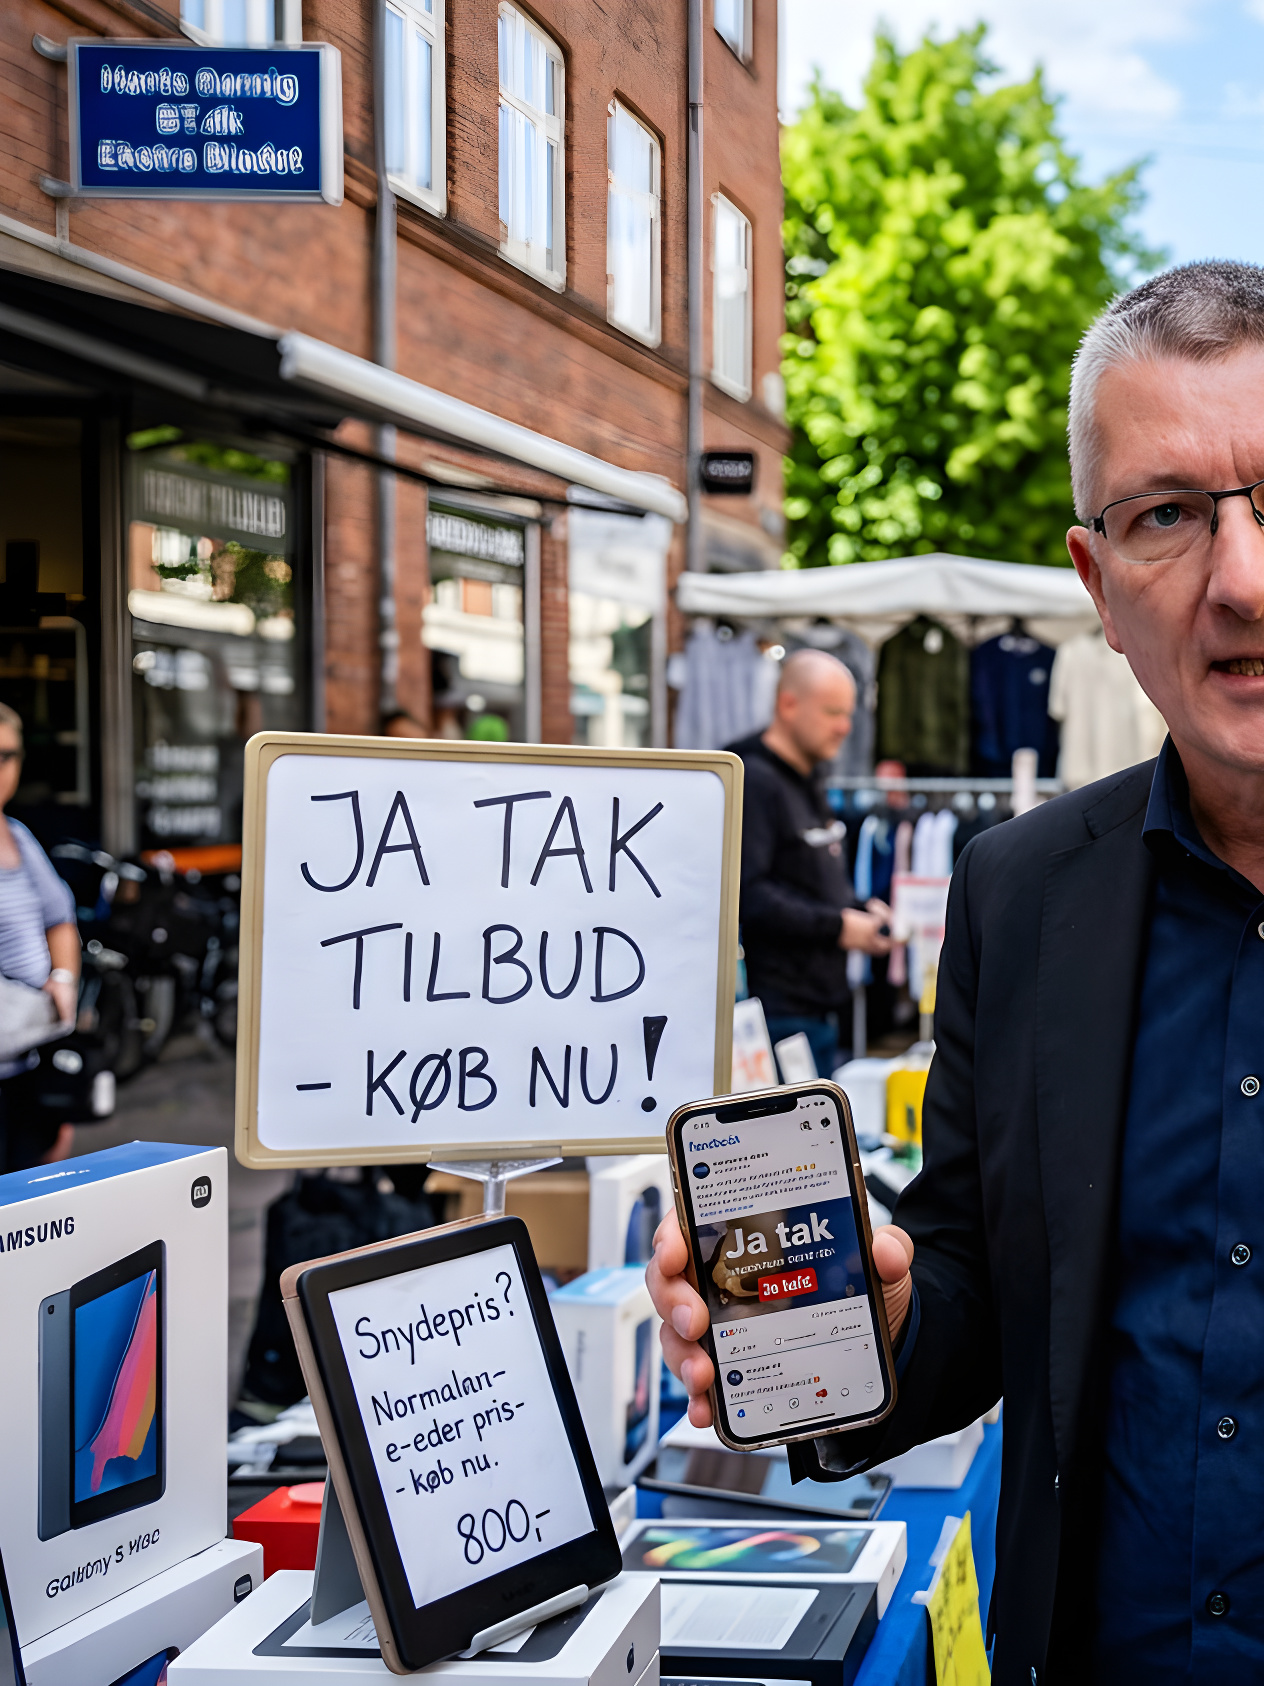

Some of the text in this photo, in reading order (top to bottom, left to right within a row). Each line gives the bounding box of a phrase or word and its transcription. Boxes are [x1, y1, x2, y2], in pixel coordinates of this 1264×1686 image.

[300, 790, 665, 898] JA TAK
[320, 922, 645, 1010] TILBUD
[366, 1046, 497, 1124] KØB
[0, 1216, 75, 1253] MSUNG
[726, 1212, 835, 1259] Ja tak
[355, 1271, 515, 1365] Snydepris?
[473, 1399, 526, 1442] pris-
[460, 1453, 500, 1478] nu.
[457, 1499, 551, 1565] 800,-
